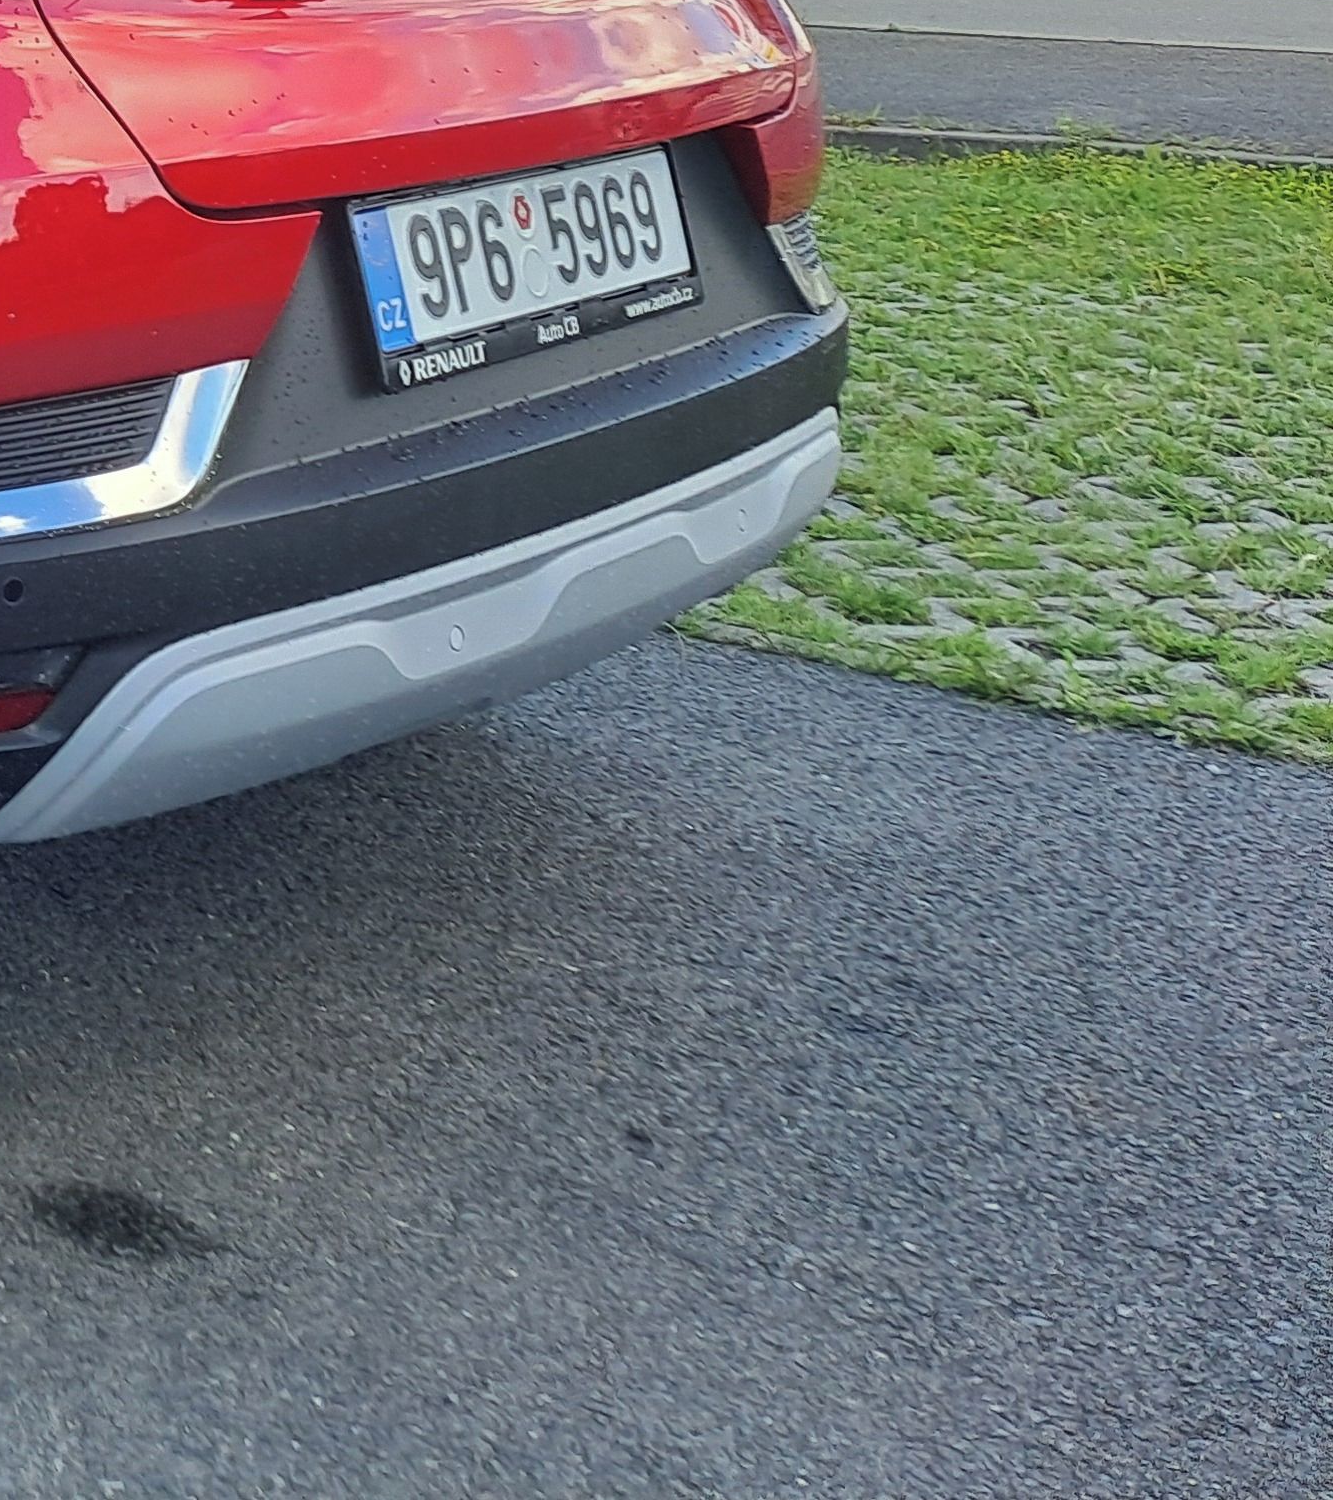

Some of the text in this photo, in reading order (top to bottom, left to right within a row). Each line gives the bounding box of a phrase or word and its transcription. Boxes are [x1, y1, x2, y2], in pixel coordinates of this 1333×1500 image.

[409, 171, 662, 318] 9P6 5969
[377, 297, 407, 331] CZ
[537, 323, 564, 344] Auto
[413, 341, 486, 381] RENAULT
